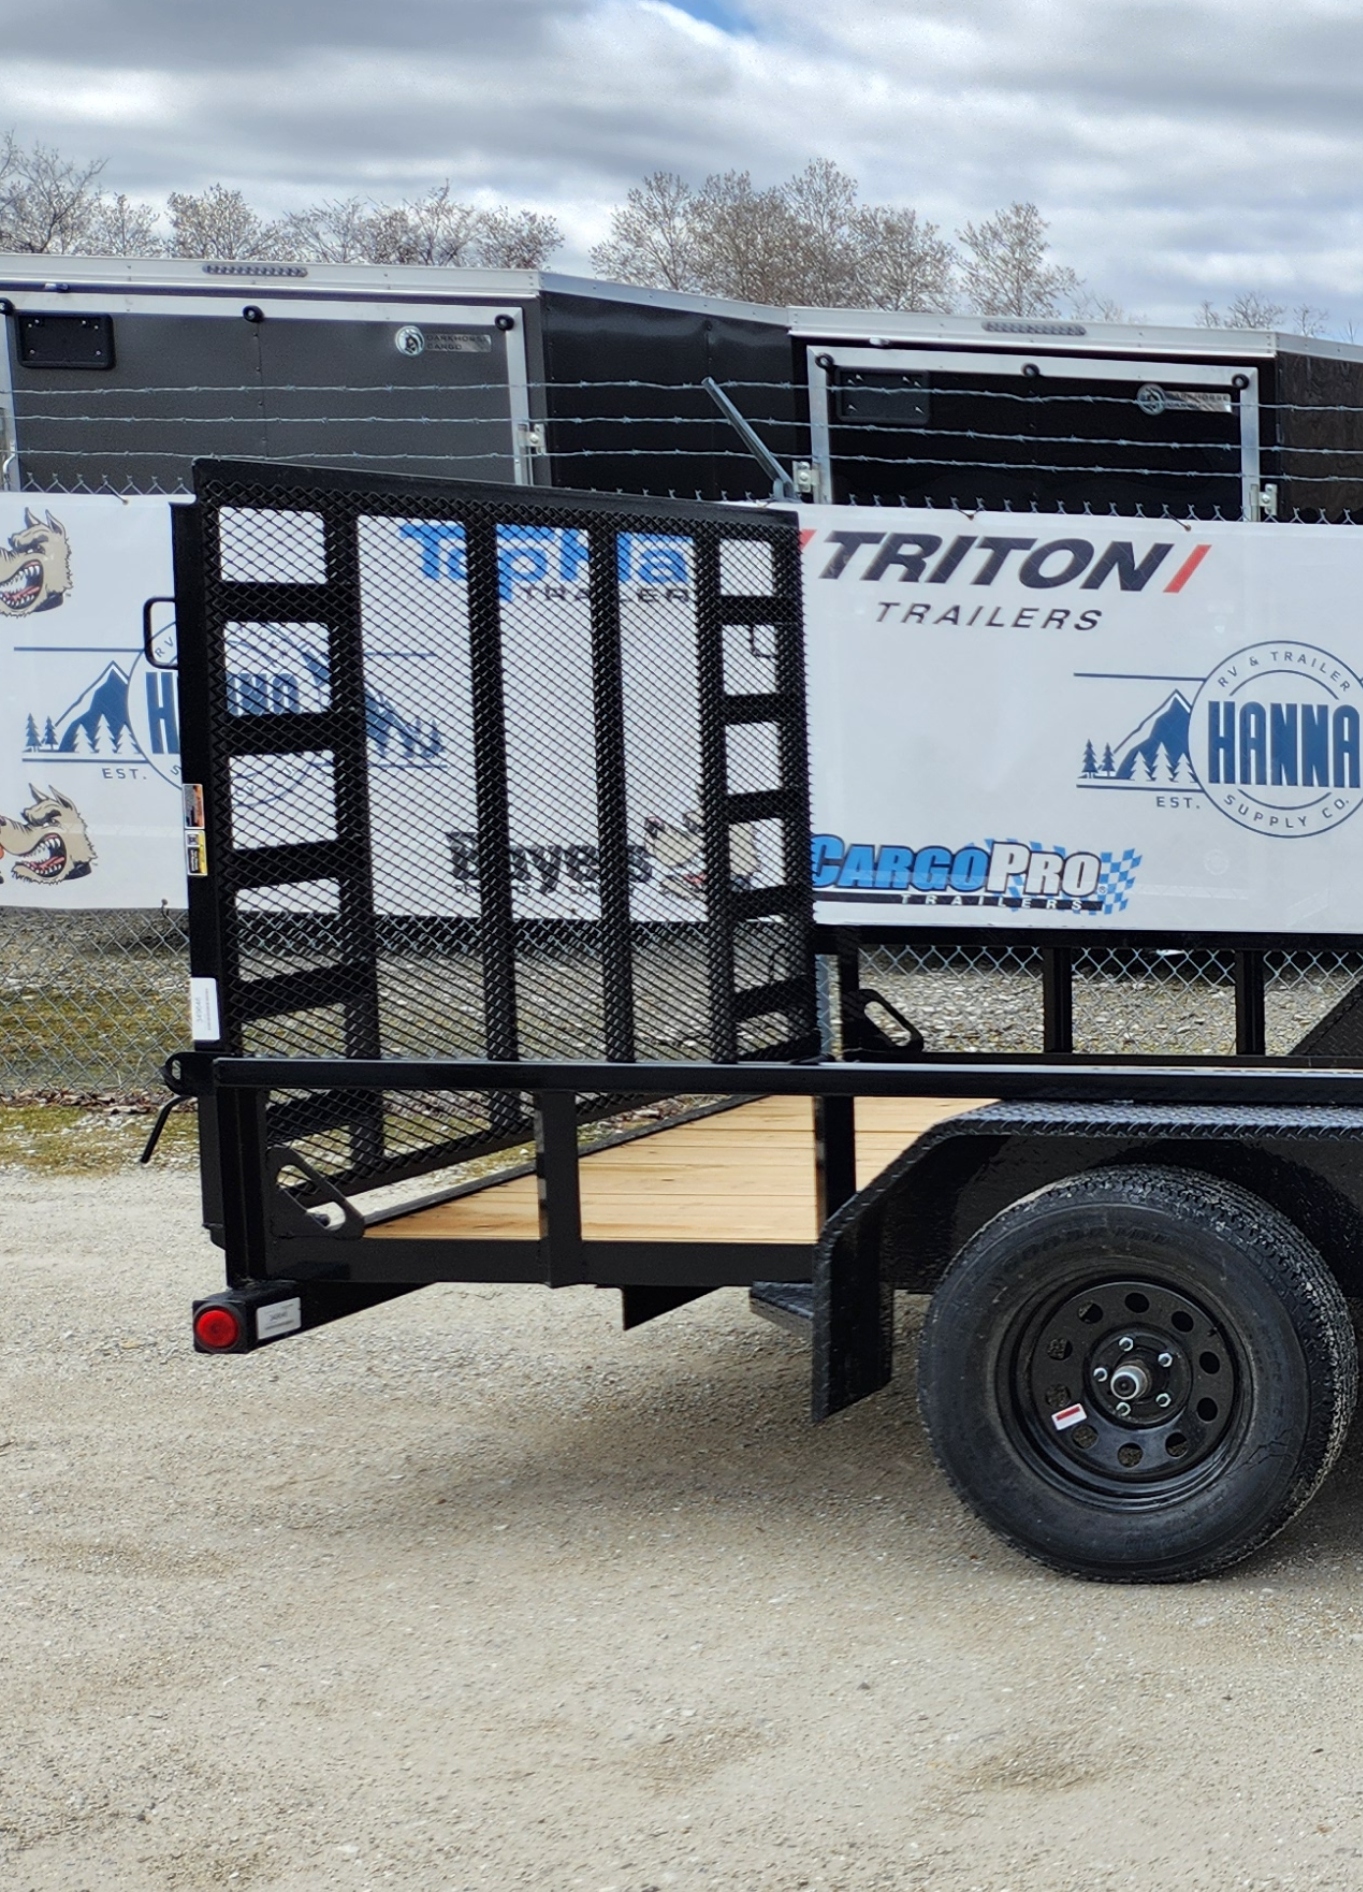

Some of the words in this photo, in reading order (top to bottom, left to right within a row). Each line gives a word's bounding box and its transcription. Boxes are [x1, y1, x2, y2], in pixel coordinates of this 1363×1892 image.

[818, 530, 1175, 593] TRITON
[875, 601, 1103, 632] TRAILERS
[1216, 666, 1238, 688] RV
[1249, 656, 1260, 667] &
[1270, 651, 1351, 692] TRAILER
[1207, 700, 1361, 789] HANNA
[102, 767, 147, 781] EST.
[1155, 795, 1201, 810] EST.
[1223, 794, 1308, 829] SUPPLY
[1321, 797, 1350, 819] CO.
[811, 834, 1102, 898] CARGOPRO
[900, 893, 1084, 911] TRAILERS
